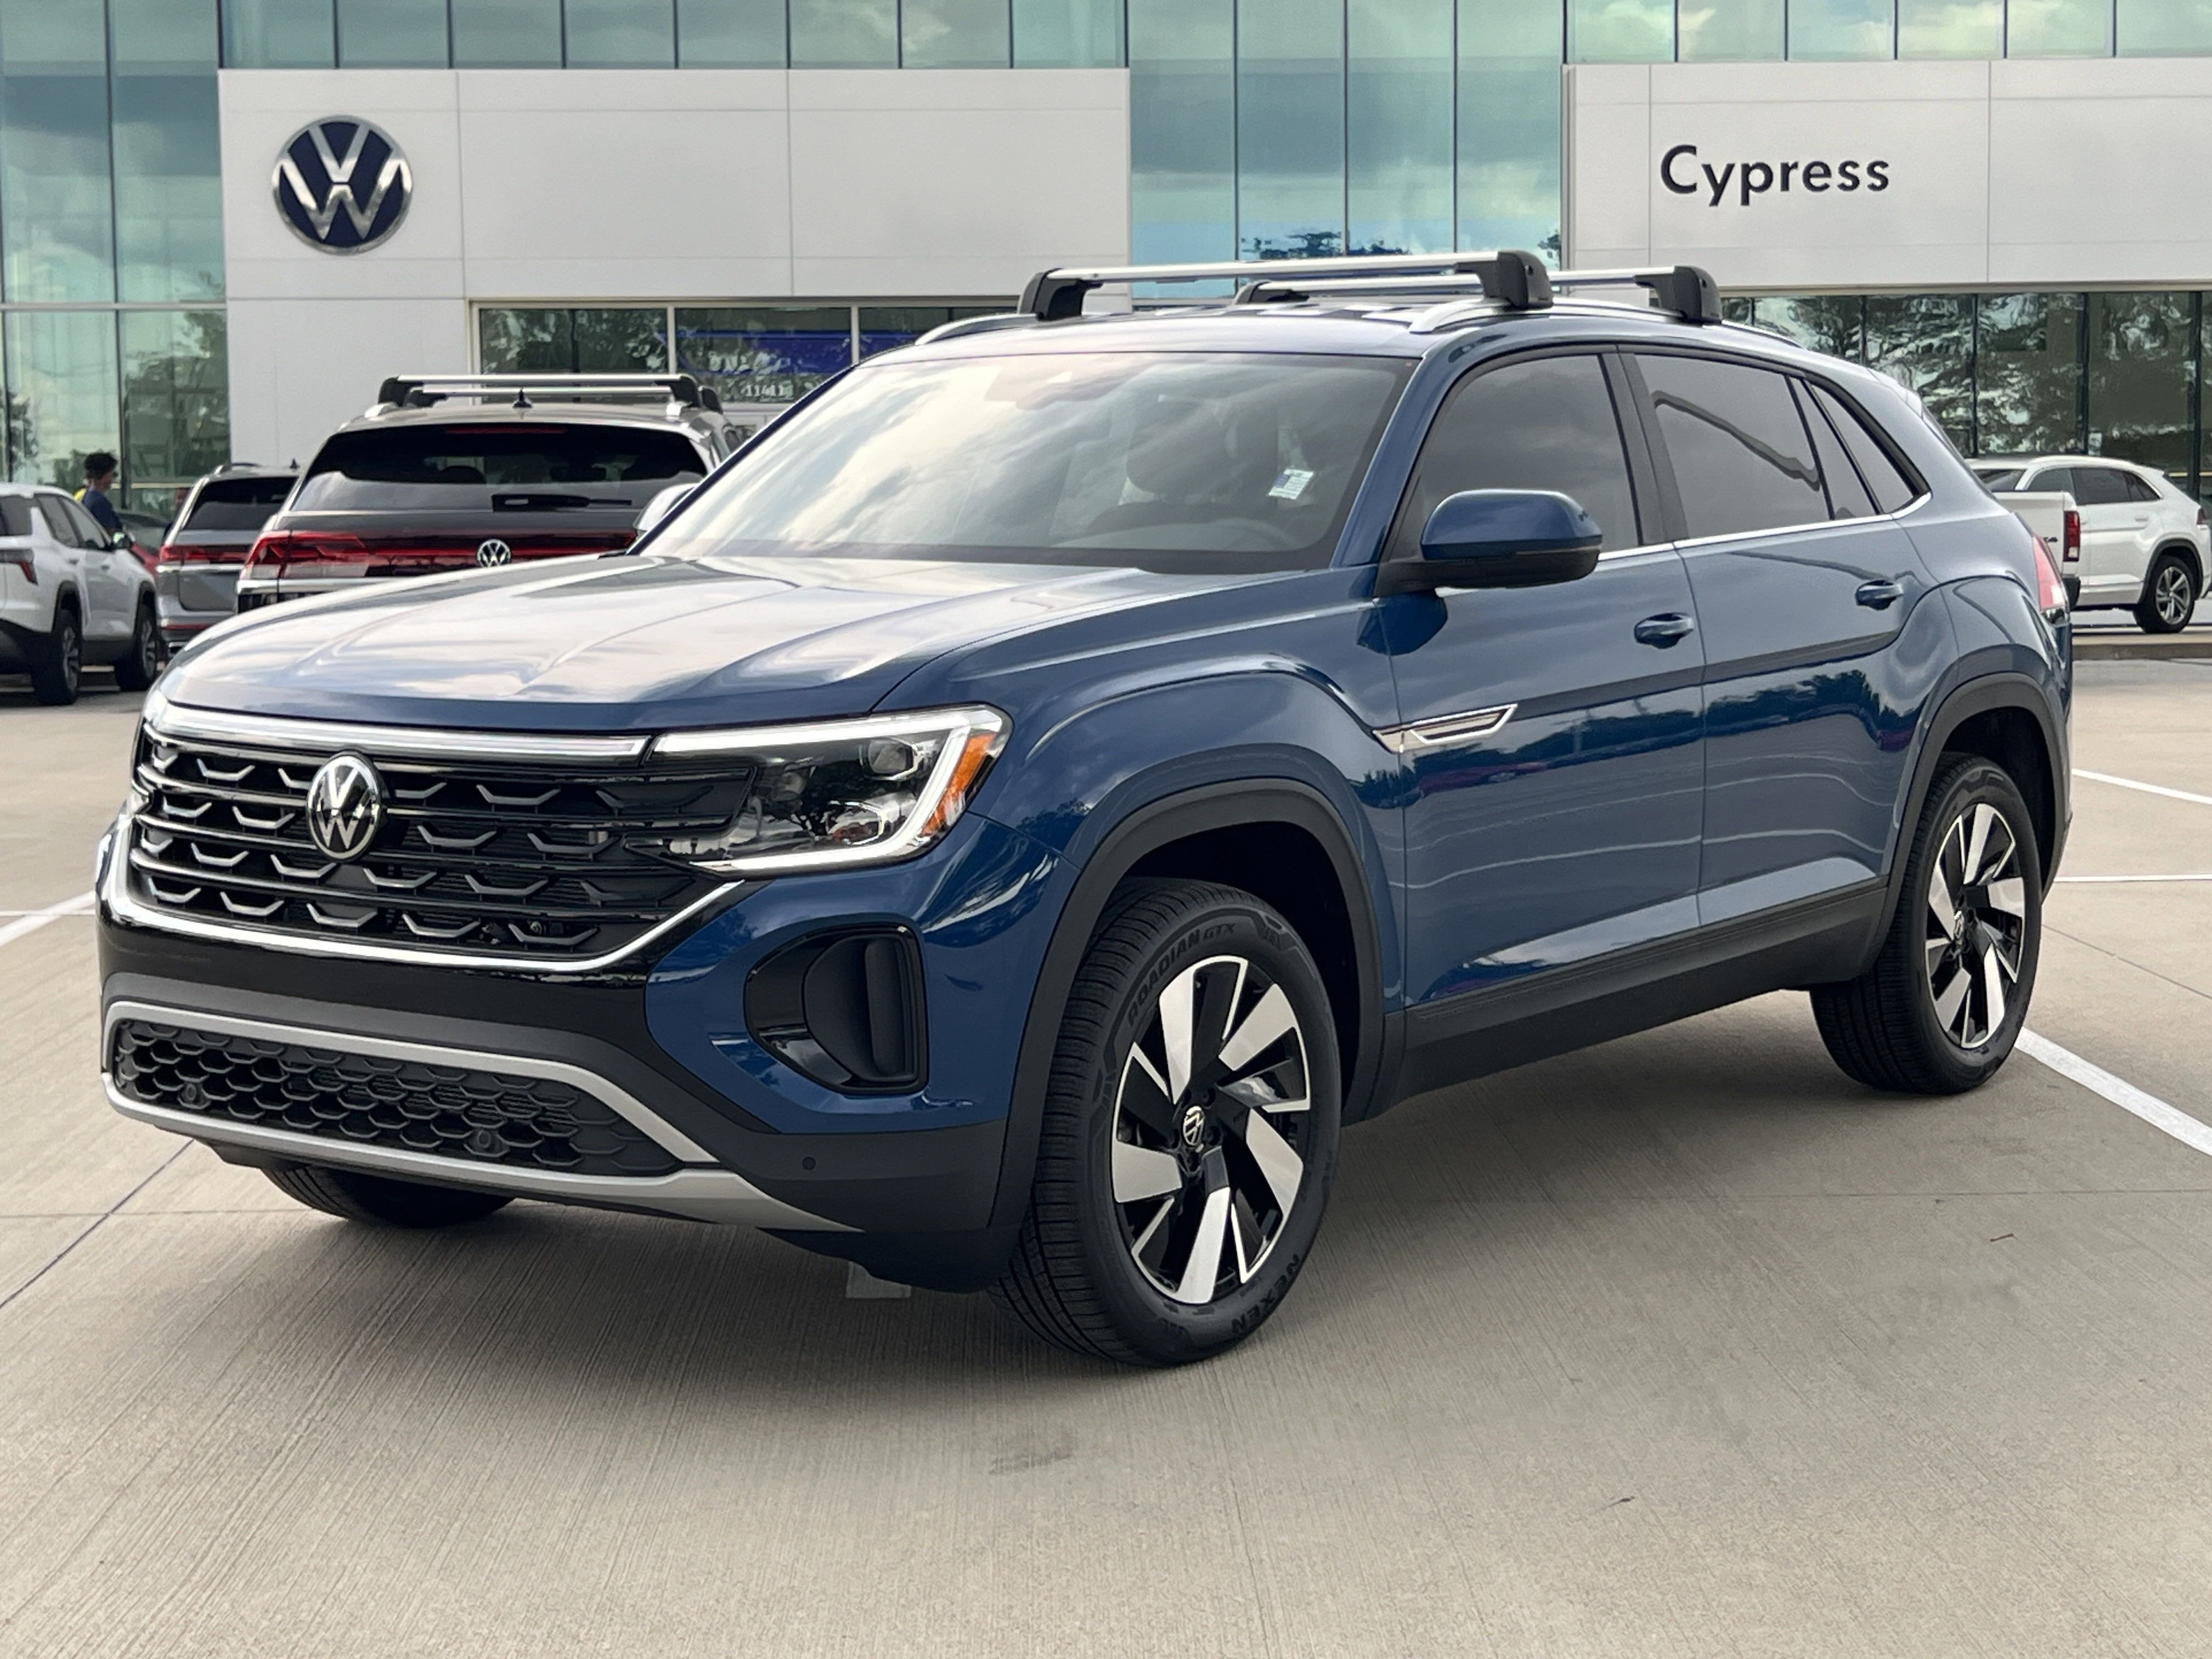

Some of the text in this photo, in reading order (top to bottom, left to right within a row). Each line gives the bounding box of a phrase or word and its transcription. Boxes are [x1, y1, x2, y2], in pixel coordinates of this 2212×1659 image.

[273, 119, 410, 244] VW
[1660, 144, 1889, 206] Cypress
[311, 760, 377, 854] VW
[1127, 928, 1200, 1028] ROADIAN
[1231, 1253, 1301, 1334] NEXEN
